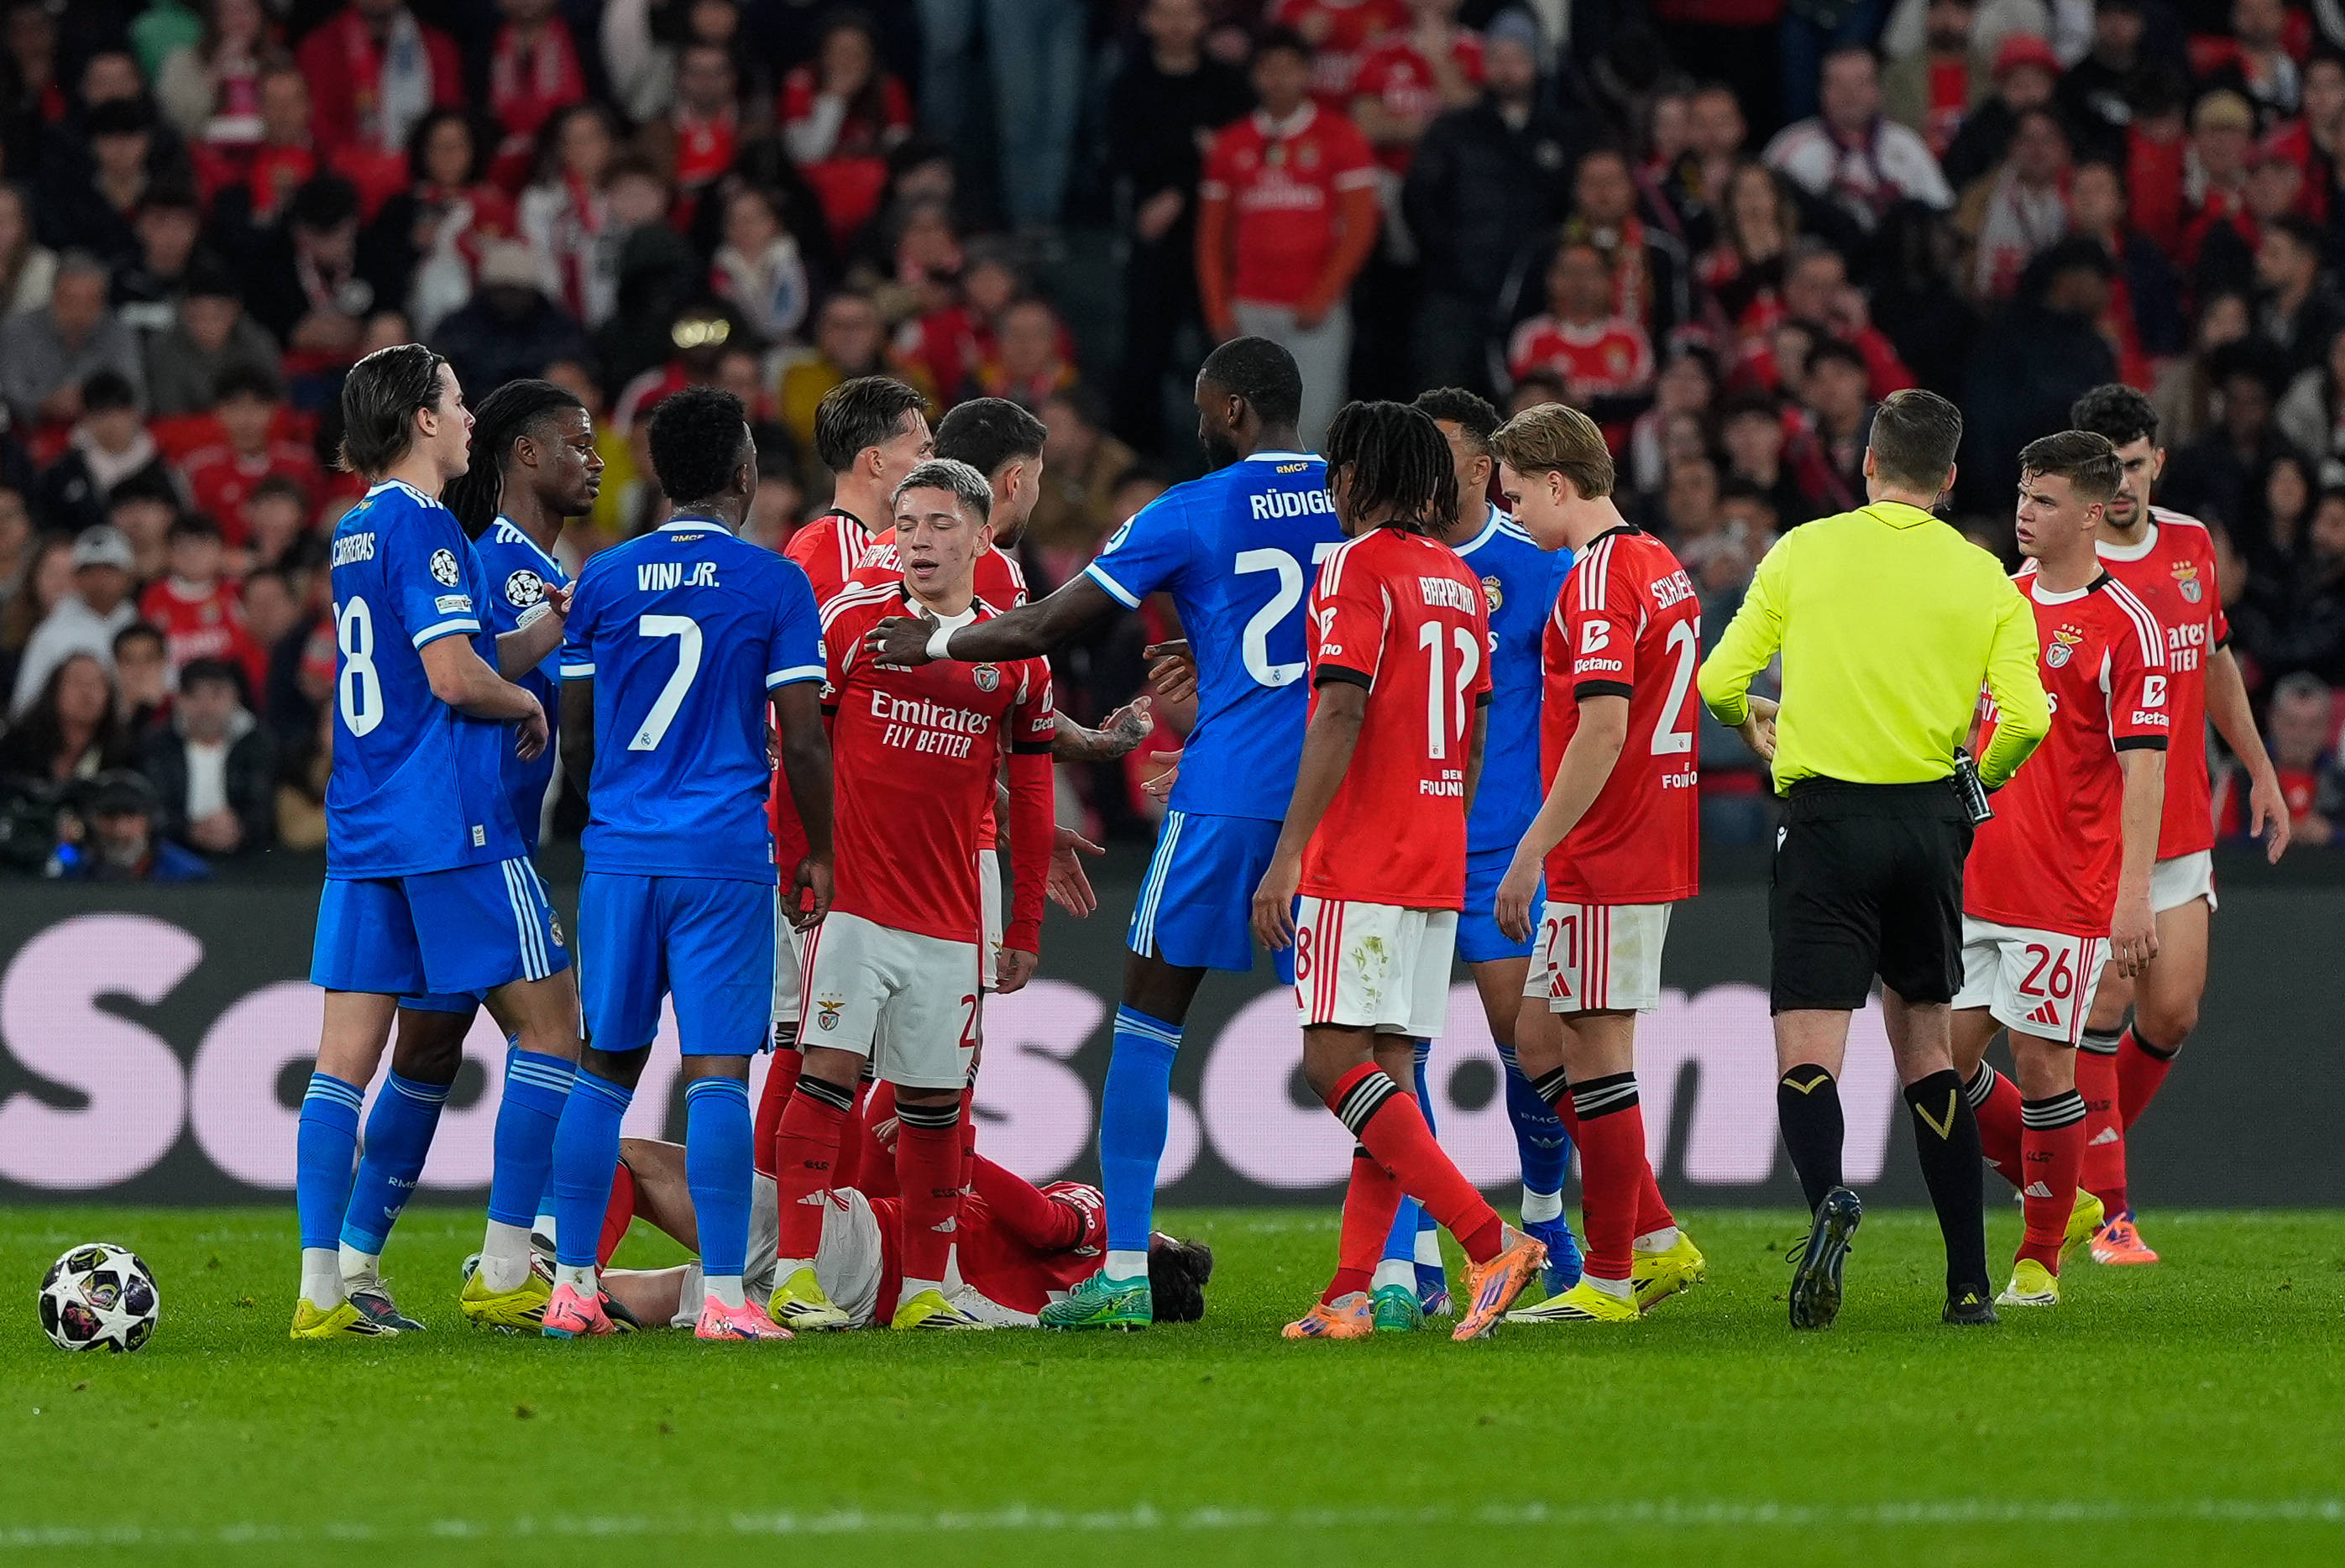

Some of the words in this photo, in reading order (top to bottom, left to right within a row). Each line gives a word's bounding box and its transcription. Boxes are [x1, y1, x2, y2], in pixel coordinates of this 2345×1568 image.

[1276, 463, 1309, 474] RMCF
[637, 562, 682, 591] VINI
[684, 562, 720, 588] JR.
[1234, 542, 1347, 687] 2
[332, 595, 385, 738] 8
[627, 614, 703, 751] 7
[1573, 657, 1623, 675] Betano
[1651, 615, 1701, 755] 2
[872, 689, 992, 735] Emirates
[882, 724, 916, 749] FLY
[915, 729, 972, 759] BETTER
[1546, 914, 1578, 971] 21
[2019, 943, 2073, 1000] 26
[959, 994, 977, 1048] 2
